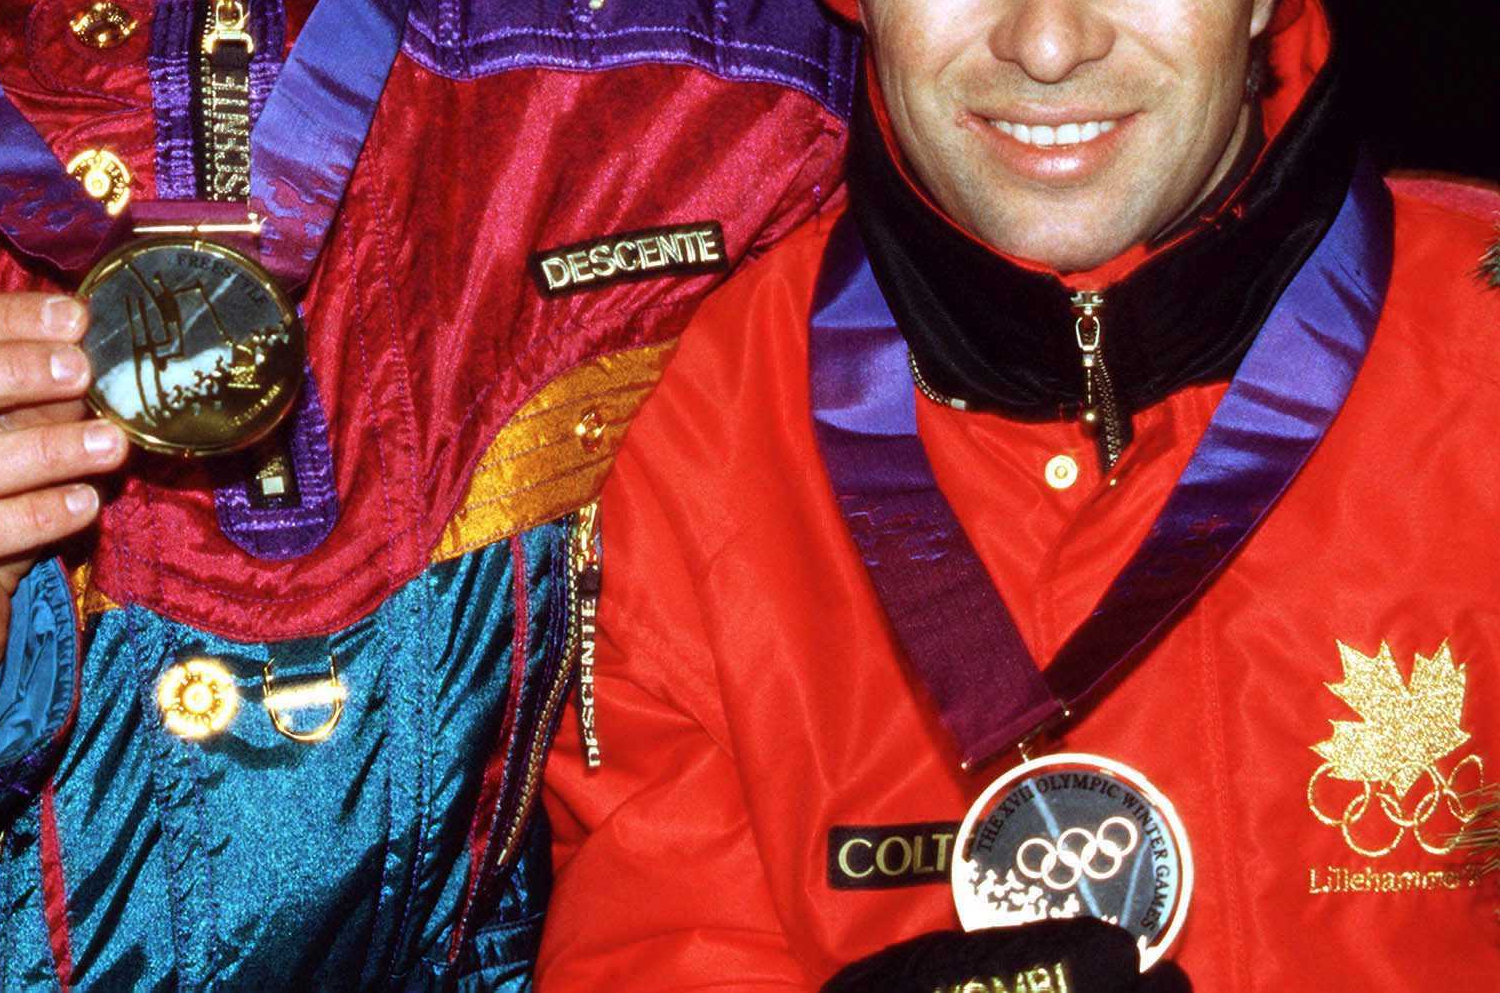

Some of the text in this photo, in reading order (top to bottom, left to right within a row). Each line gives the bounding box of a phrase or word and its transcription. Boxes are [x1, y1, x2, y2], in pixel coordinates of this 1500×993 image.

[211, 72, 251, 201] SCENTE
[541, 230, 719, 290] DESCENTE
[580, 598, 601, 768] DESCENTE
[1035, 773, 1121, 799] OLYMPIC
[838, 833, 954, 878] COLT
[976, 814, 1004, 854] THE
[1122, 792, 1169, 861] WINTER
[1140, 864, 1171, 930] GAMES
[1309, 865, 1475, 895] Lillehamme
